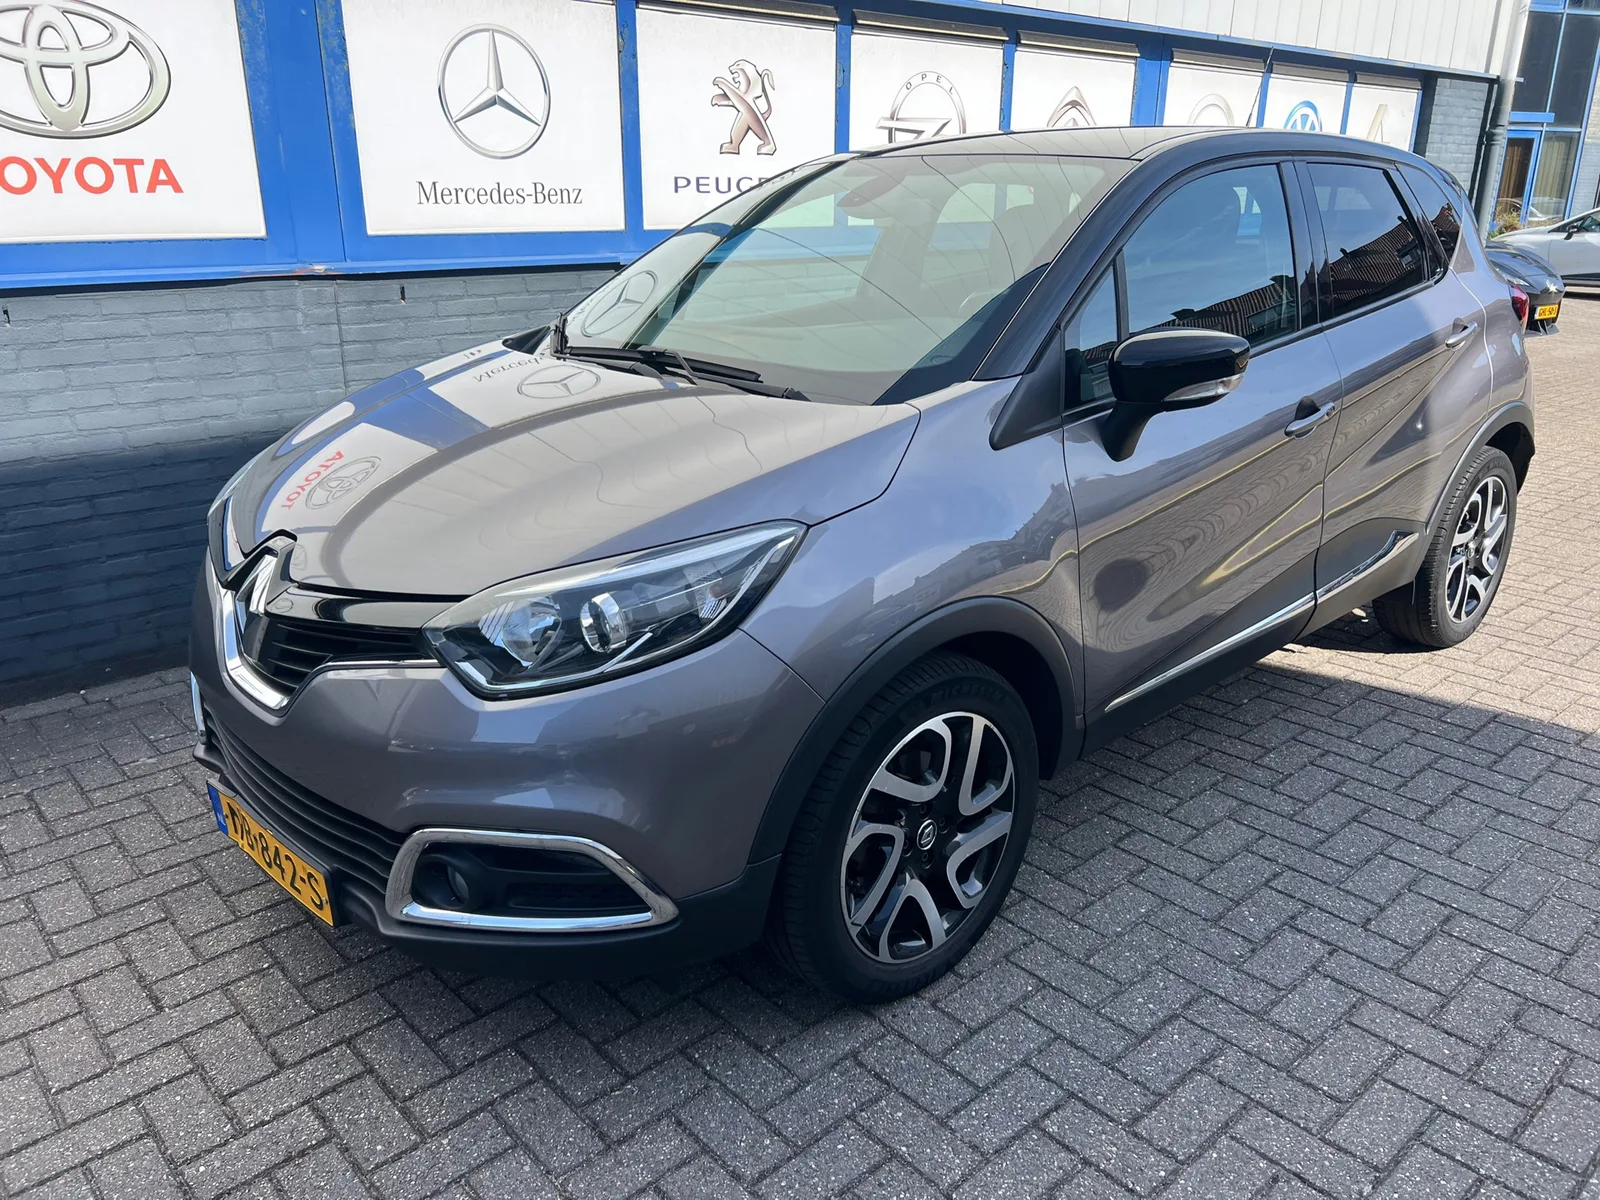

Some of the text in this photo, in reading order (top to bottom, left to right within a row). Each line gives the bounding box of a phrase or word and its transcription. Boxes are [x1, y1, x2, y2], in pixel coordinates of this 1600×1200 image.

[905, 73, 954, 95] OPEL
[0, 156, 184, 195] OYOTA
[416, 181, 583, 206] Mercedes-Benz
